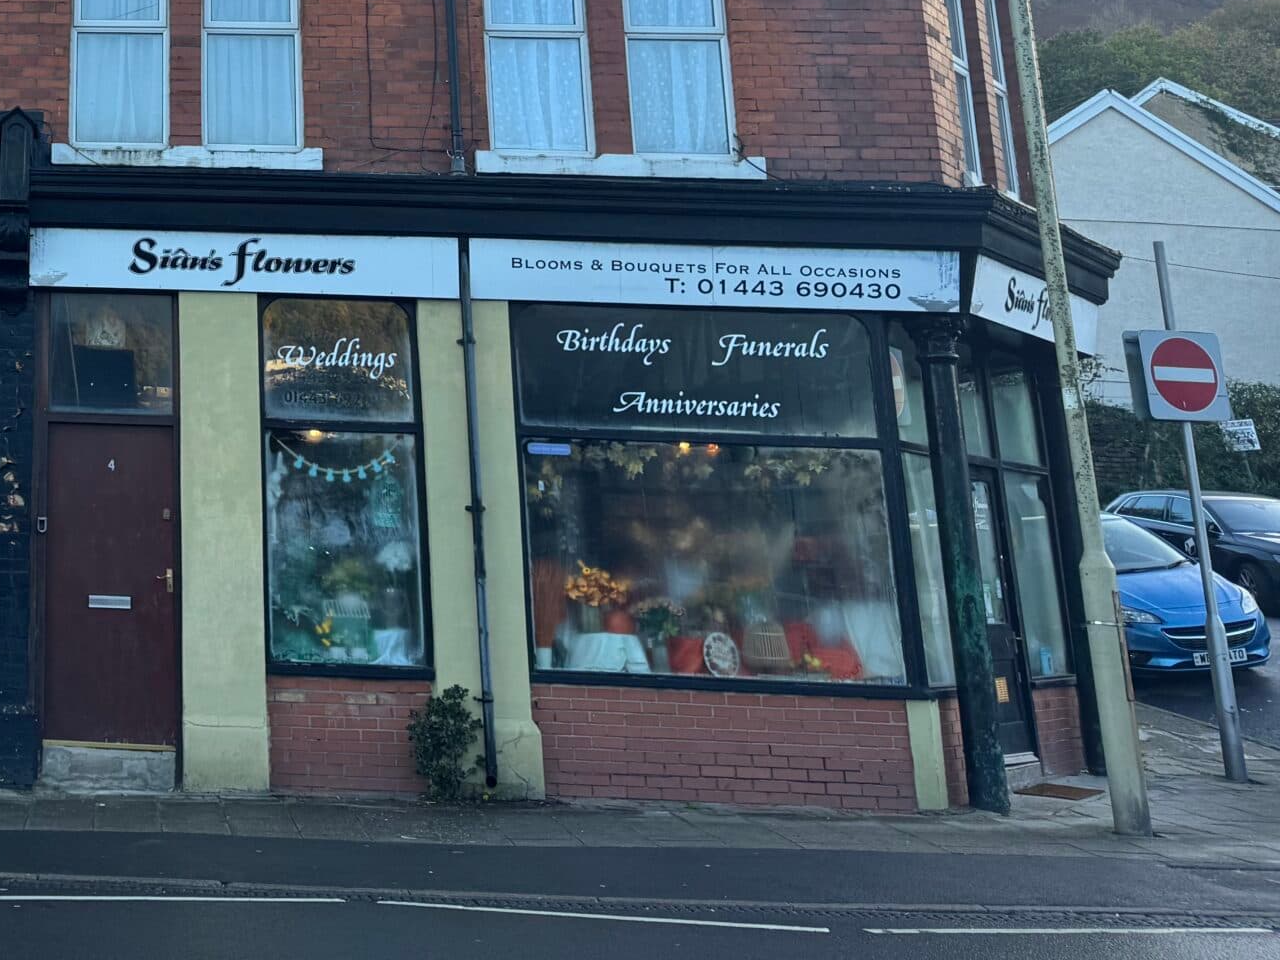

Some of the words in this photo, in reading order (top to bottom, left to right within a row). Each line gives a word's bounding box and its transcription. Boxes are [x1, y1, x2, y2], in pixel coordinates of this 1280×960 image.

[591, 259, 604, 271] &
[665, 277, 686, 294] T:
[697, 279, 785, 297] 01443
[796, 281, 902, 301] 690430
[556, 323, 672, 365] Birthdays
[711, 328, 830, 366] Funerals
[277, 337, 398, 380] Weddings
[613, 391, 781, 418] Anniversaries
[107, 459, 116, 471] 4
